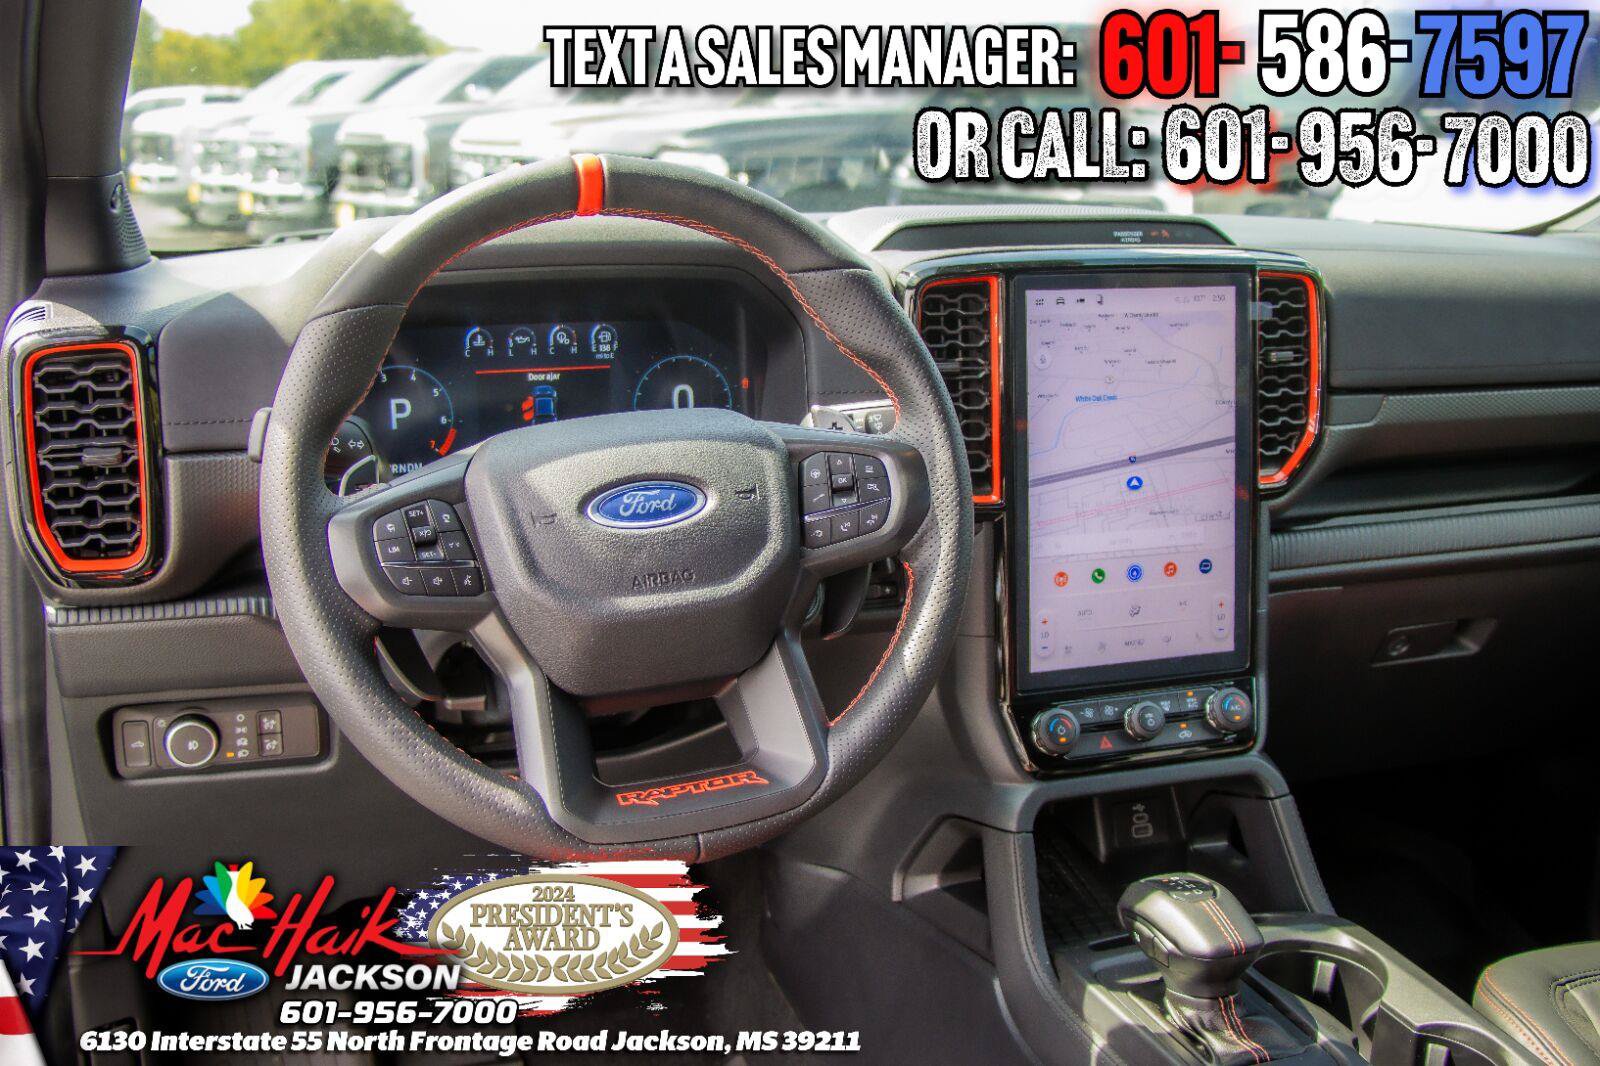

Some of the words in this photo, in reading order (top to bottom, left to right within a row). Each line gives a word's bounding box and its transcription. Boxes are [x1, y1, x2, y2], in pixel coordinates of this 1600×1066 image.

[528, 373, 545, 381] Door
[546, 373, 560, 382] ajar
[390, 398, 412, 430] P
[619, 490, 676, 517] Ford
[632, 570, 696, 591] AIRBAG
[616, 771, 769, 806] RAPTOR
